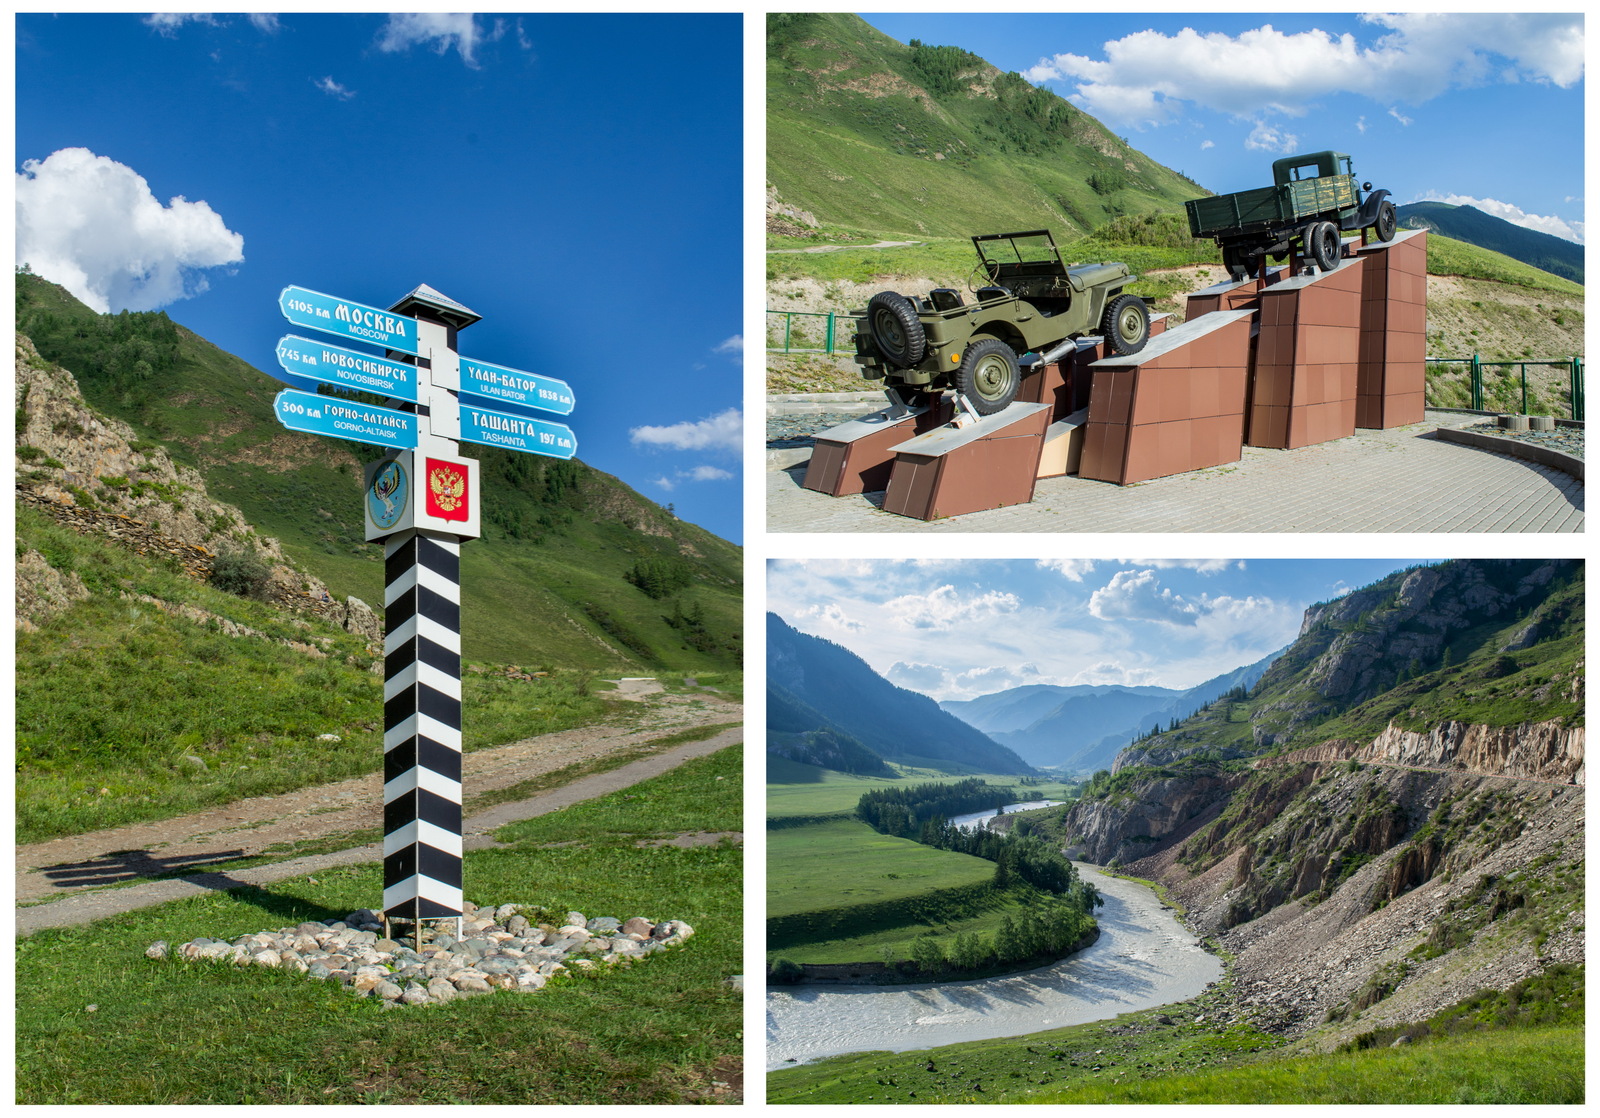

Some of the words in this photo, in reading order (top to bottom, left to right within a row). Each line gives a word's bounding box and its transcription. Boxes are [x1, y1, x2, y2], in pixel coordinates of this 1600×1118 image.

[288, 299, 313, 314] 4105
[334, 304, 406, 336] МОСКВА
[349, 325, 389, 341] MOSCOW
[281, 347, 299, 361] 745
[322, 350, 406, 381] НОВОСИБИРСК
[337, 370, 394, 390] NOVOSIBIRSK
[468, 366, 536, 392] УЛАН-БАТОР
[539, 389, 557, 401] 1838
[481, 385, 500, 395] ULAN
[501, 390, 526, 401] BATOR
[282, 402, 304, 414] 300
[324, 404, 407, 429] ГОРНО-АЛТАЙСК
[334, 421, 396, 439] GORNO-ALTAISK
[471, 412, 535, 437] ТАШАНТА
[540, 432, 555, 445] 197
[481, 431, 526, 447] TASHANTA
